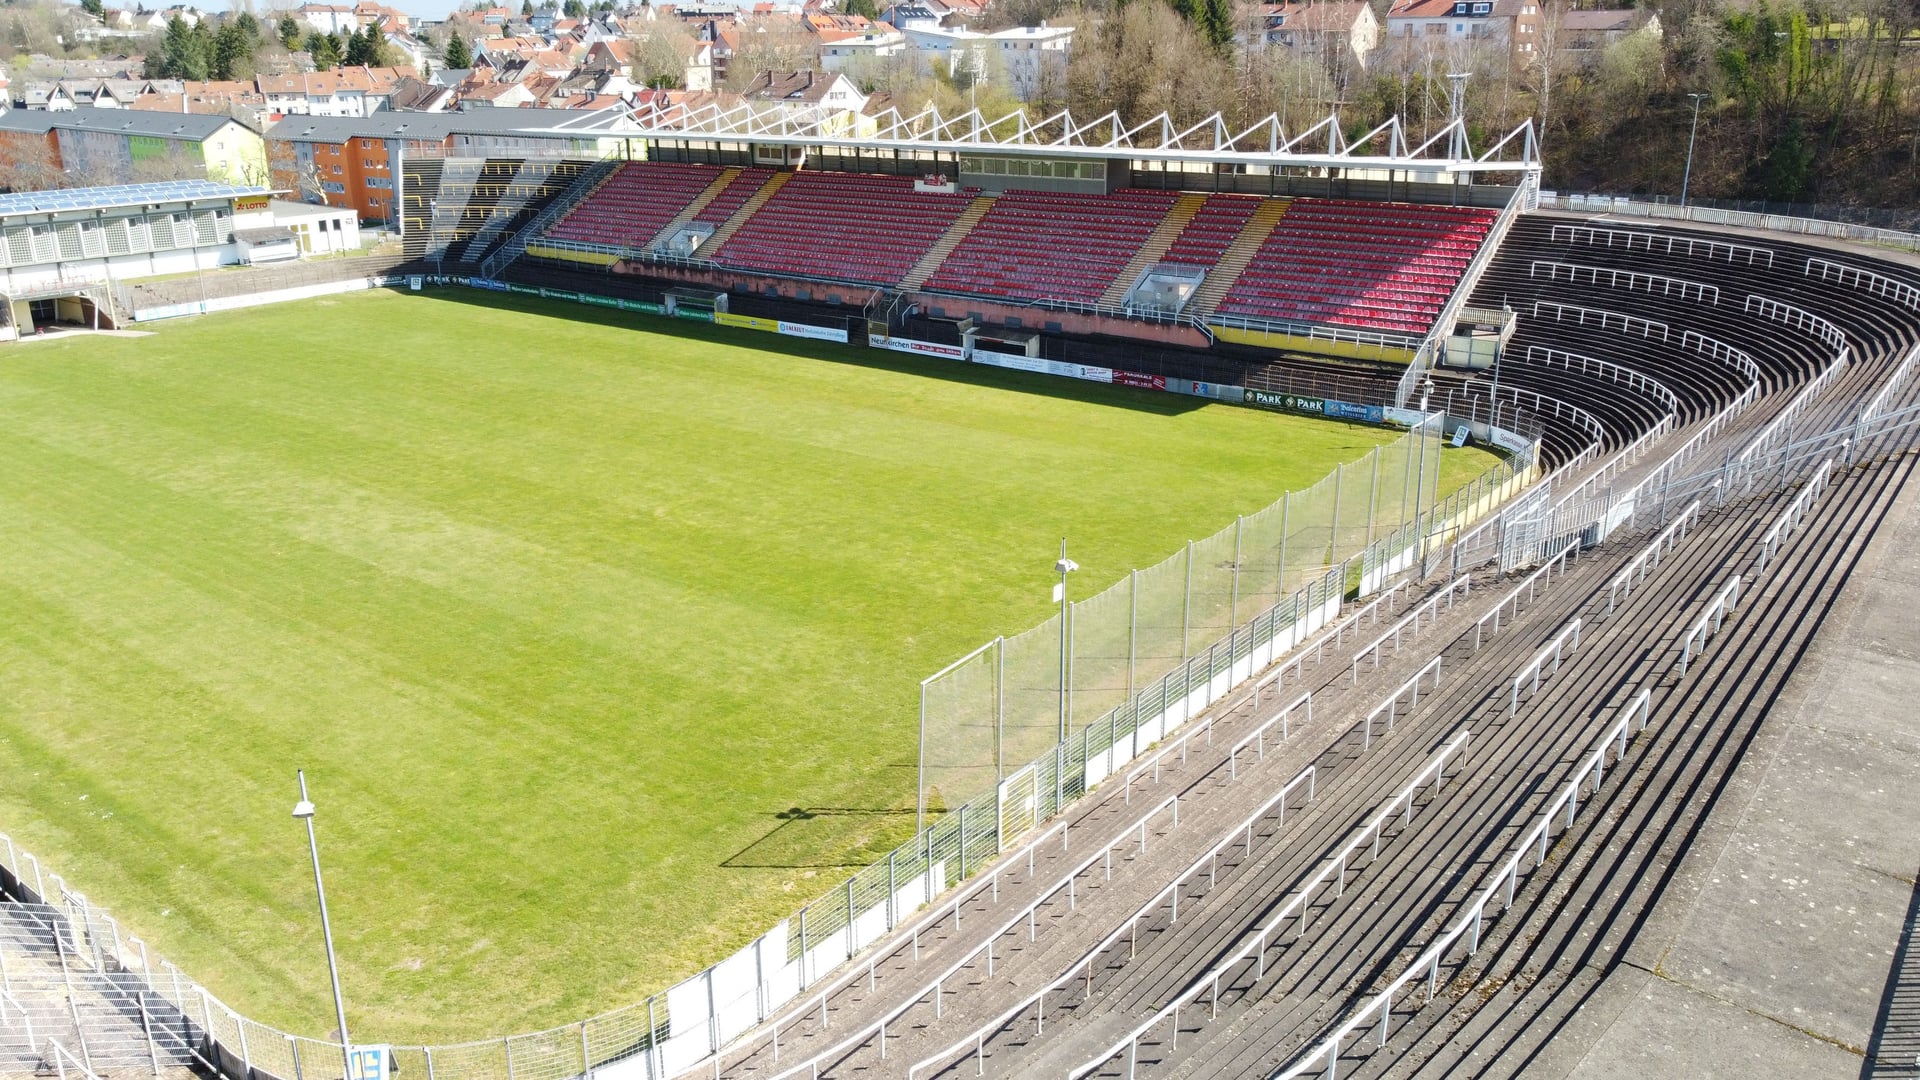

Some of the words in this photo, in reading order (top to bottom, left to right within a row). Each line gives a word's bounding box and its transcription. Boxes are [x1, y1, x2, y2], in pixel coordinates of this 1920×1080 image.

[246, 202, 268, 210] LOTTO
[1256, 393, 1282, 404] PARK
[1297, 399, 1323, 411] PARK
